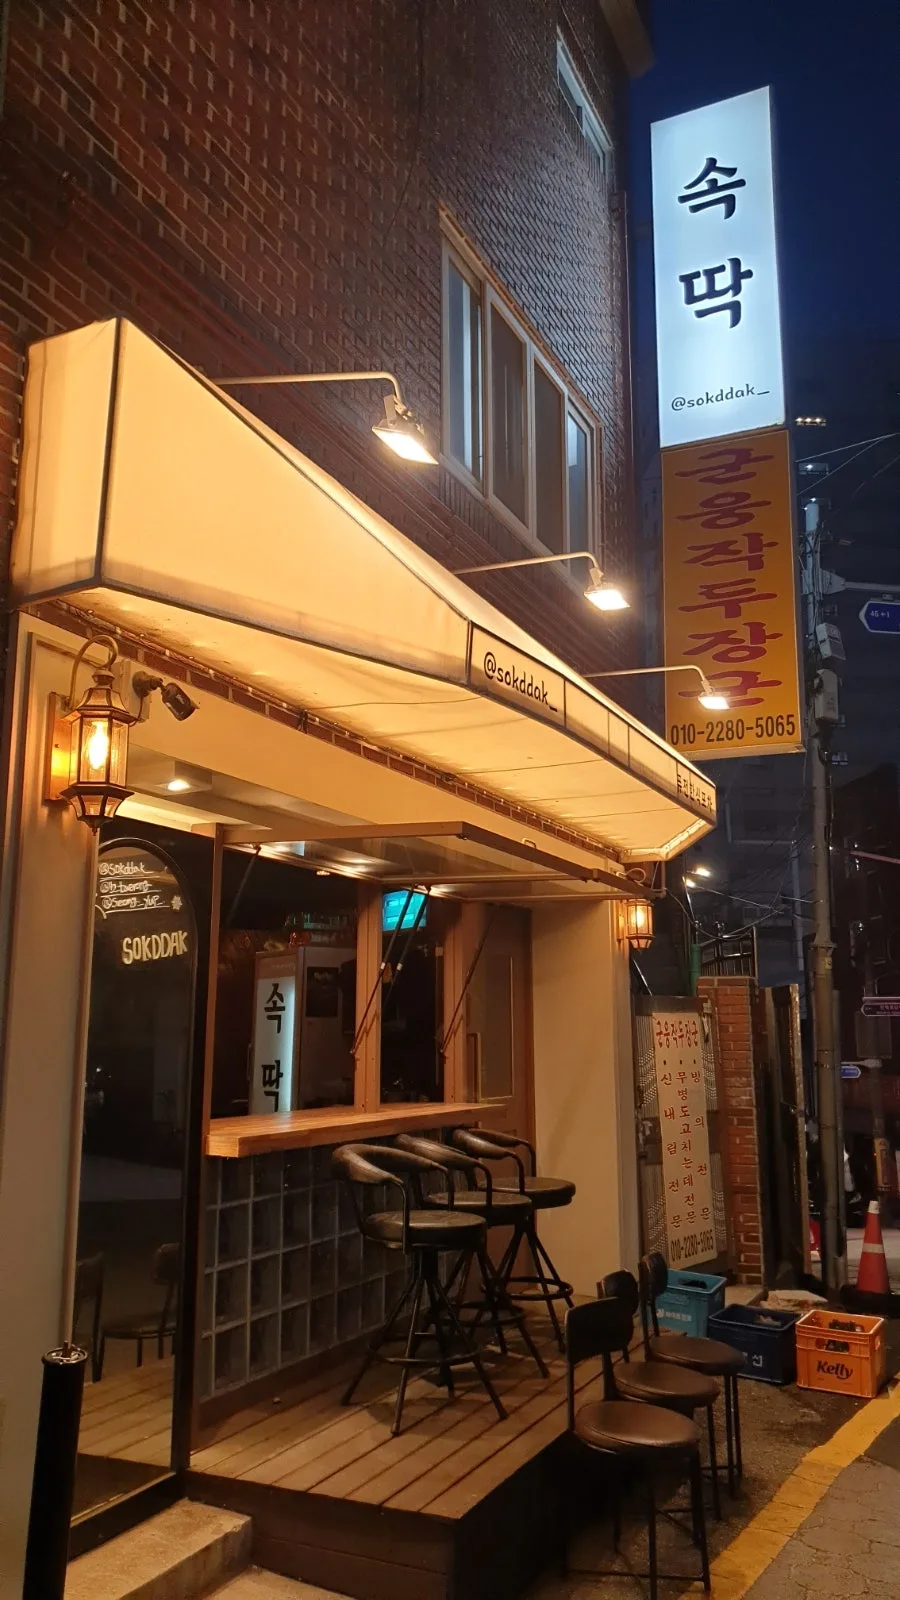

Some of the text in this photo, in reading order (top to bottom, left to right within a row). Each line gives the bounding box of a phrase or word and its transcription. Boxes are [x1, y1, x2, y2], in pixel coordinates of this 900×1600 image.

[677, 156, 754, 329] 속딱
[671, 383, 770, 411] @sokddak_
[483, 651, 558, 712] @sokddak_
[671, 714, 796, 746] 010-2280-5065
[122, 930, 188, 965] SOKDDAK
[816, 1359, 854, 1380] Kelly
